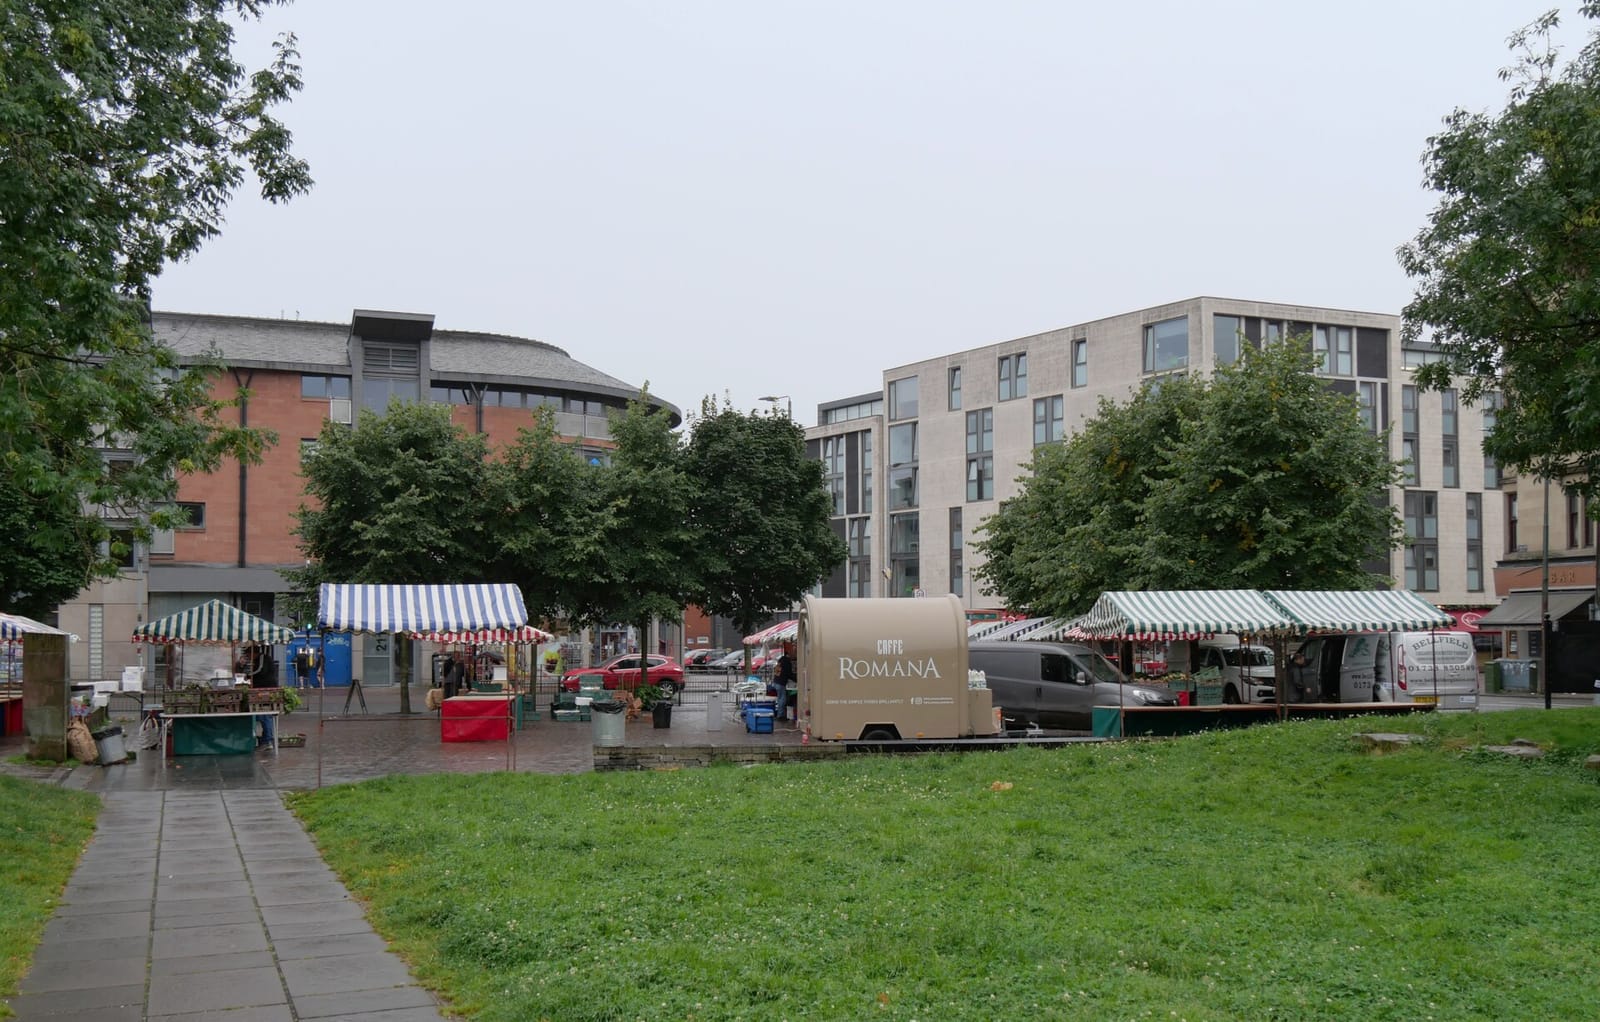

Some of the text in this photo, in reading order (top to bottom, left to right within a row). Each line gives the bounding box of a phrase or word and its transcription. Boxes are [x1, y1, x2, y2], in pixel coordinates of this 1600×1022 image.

[1551, 569, 1575, 583] BAR
[877, 639, 904, 655] CAFFE
[1412, 636, 1469, 650] BELLFIELD
[838, 657, 941, 680] ROMANA
